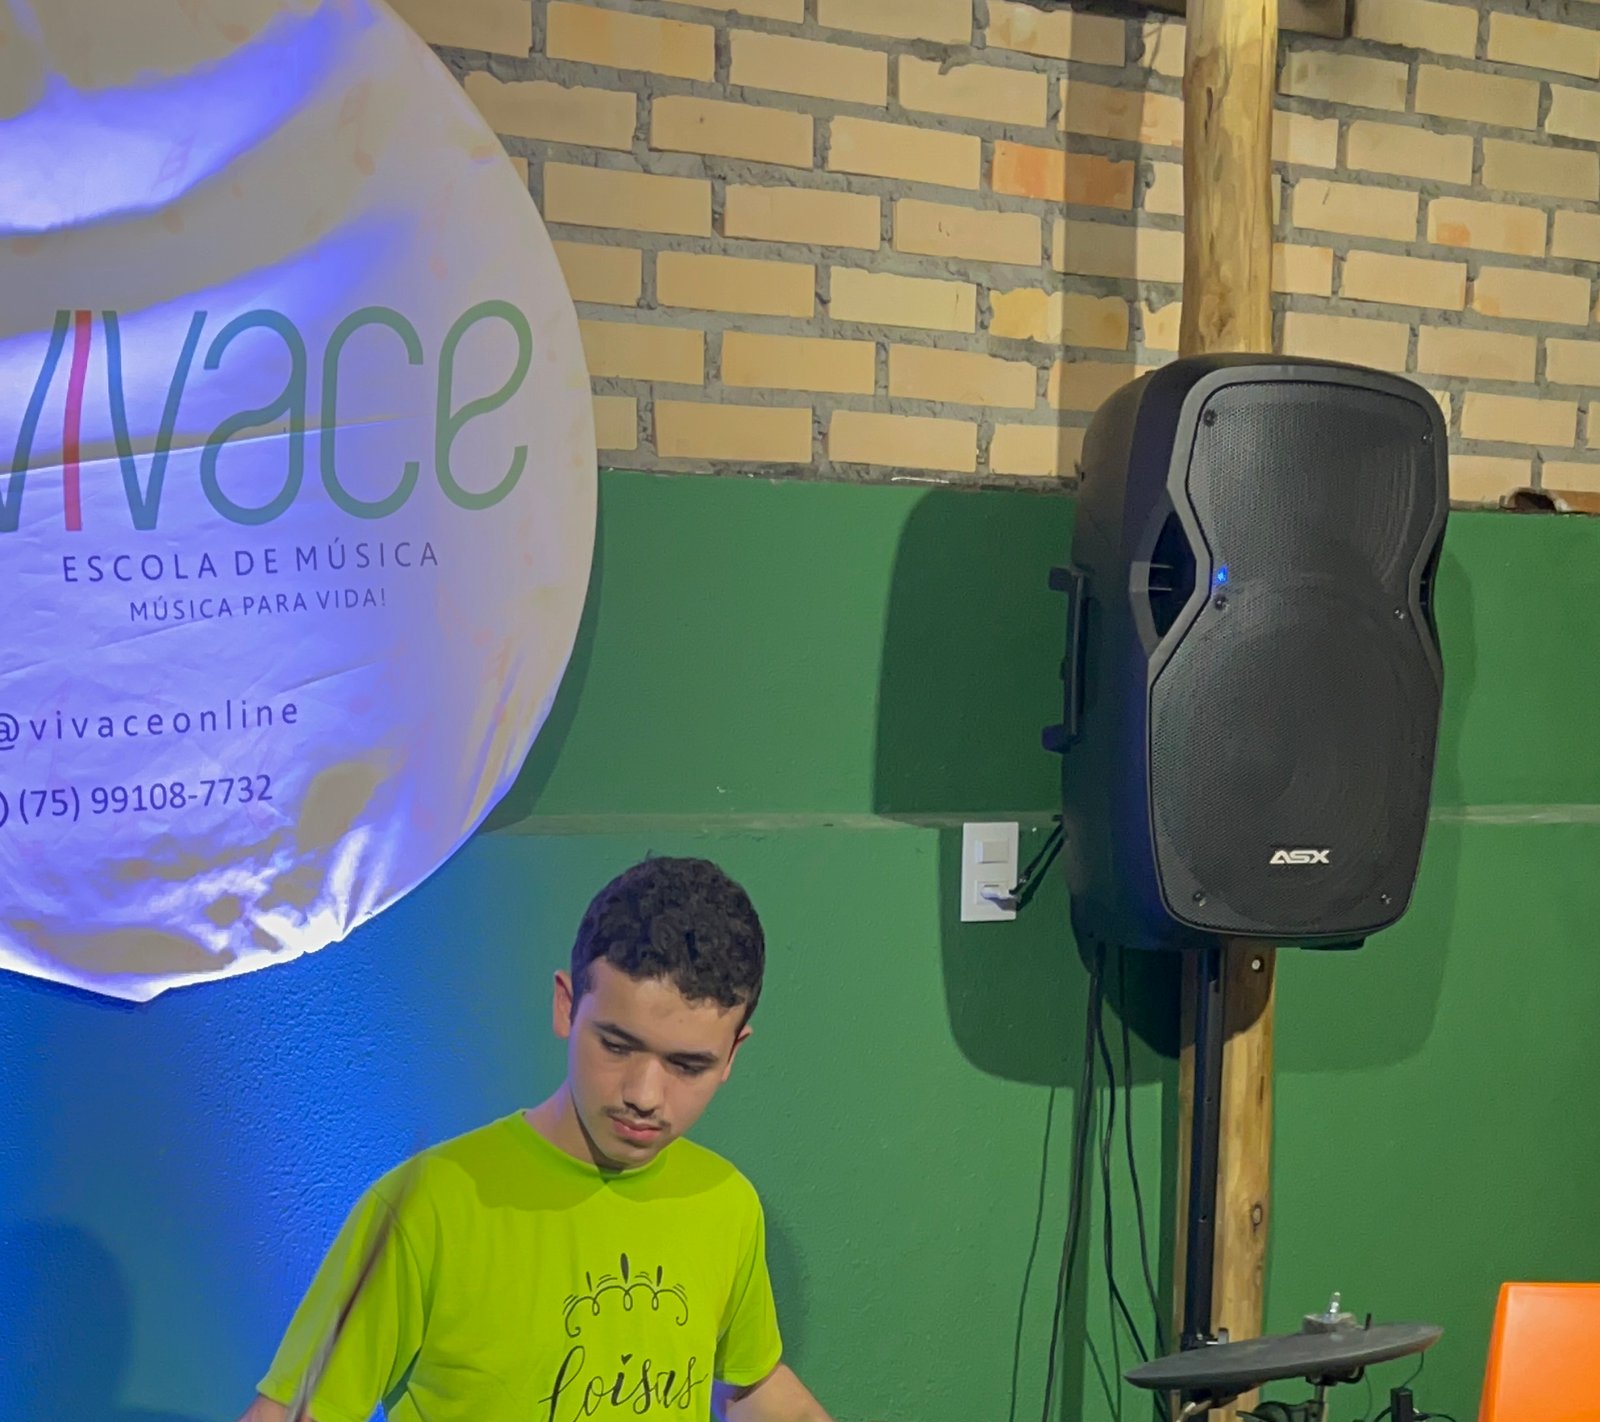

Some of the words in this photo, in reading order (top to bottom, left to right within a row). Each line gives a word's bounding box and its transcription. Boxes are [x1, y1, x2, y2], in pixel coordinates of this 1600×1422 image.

[62, 552, 218, 583] ESCOLA
[234, 547, 279, 576] DE
[296, 536, 439, 572] MÚSICA
[129, 595, 233, 622] MÚSICA
[242, 592, 308, 616] PARA
[315, 587, 387, 610] VIDA!
[0, 699, 298, 751] @vivaceonline
[19, 786, 80, 825] (75)
[91, 774, 273, 815] 99108-7732
[1269, 849, 1330, 864] ASX
